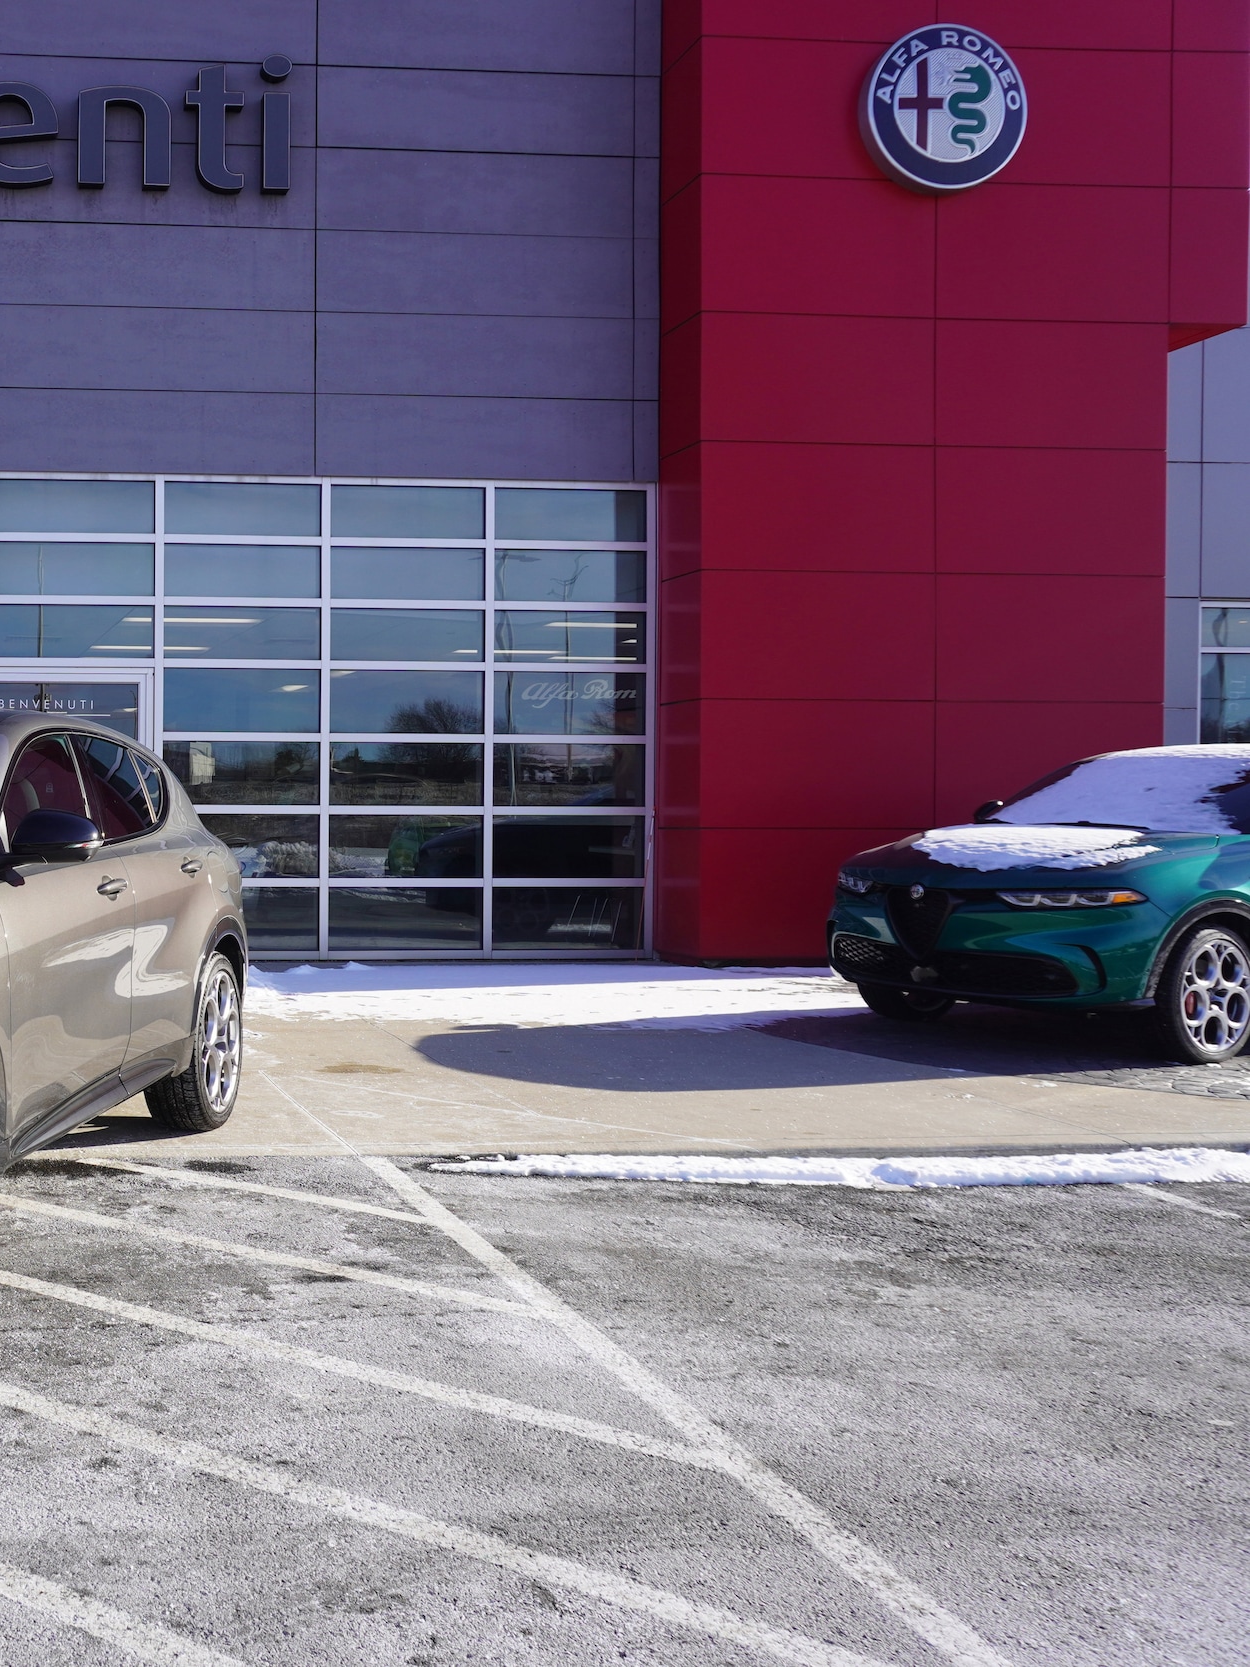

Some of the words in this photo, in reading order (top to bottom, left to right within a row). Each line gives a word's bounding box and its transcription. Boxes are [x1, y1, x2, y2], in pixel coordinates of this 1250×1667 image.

[875, 38, 929, 105] ALFA
[940, 30, 1021, 111] ROMEO
[521, 682, 579, 709] Alfa
